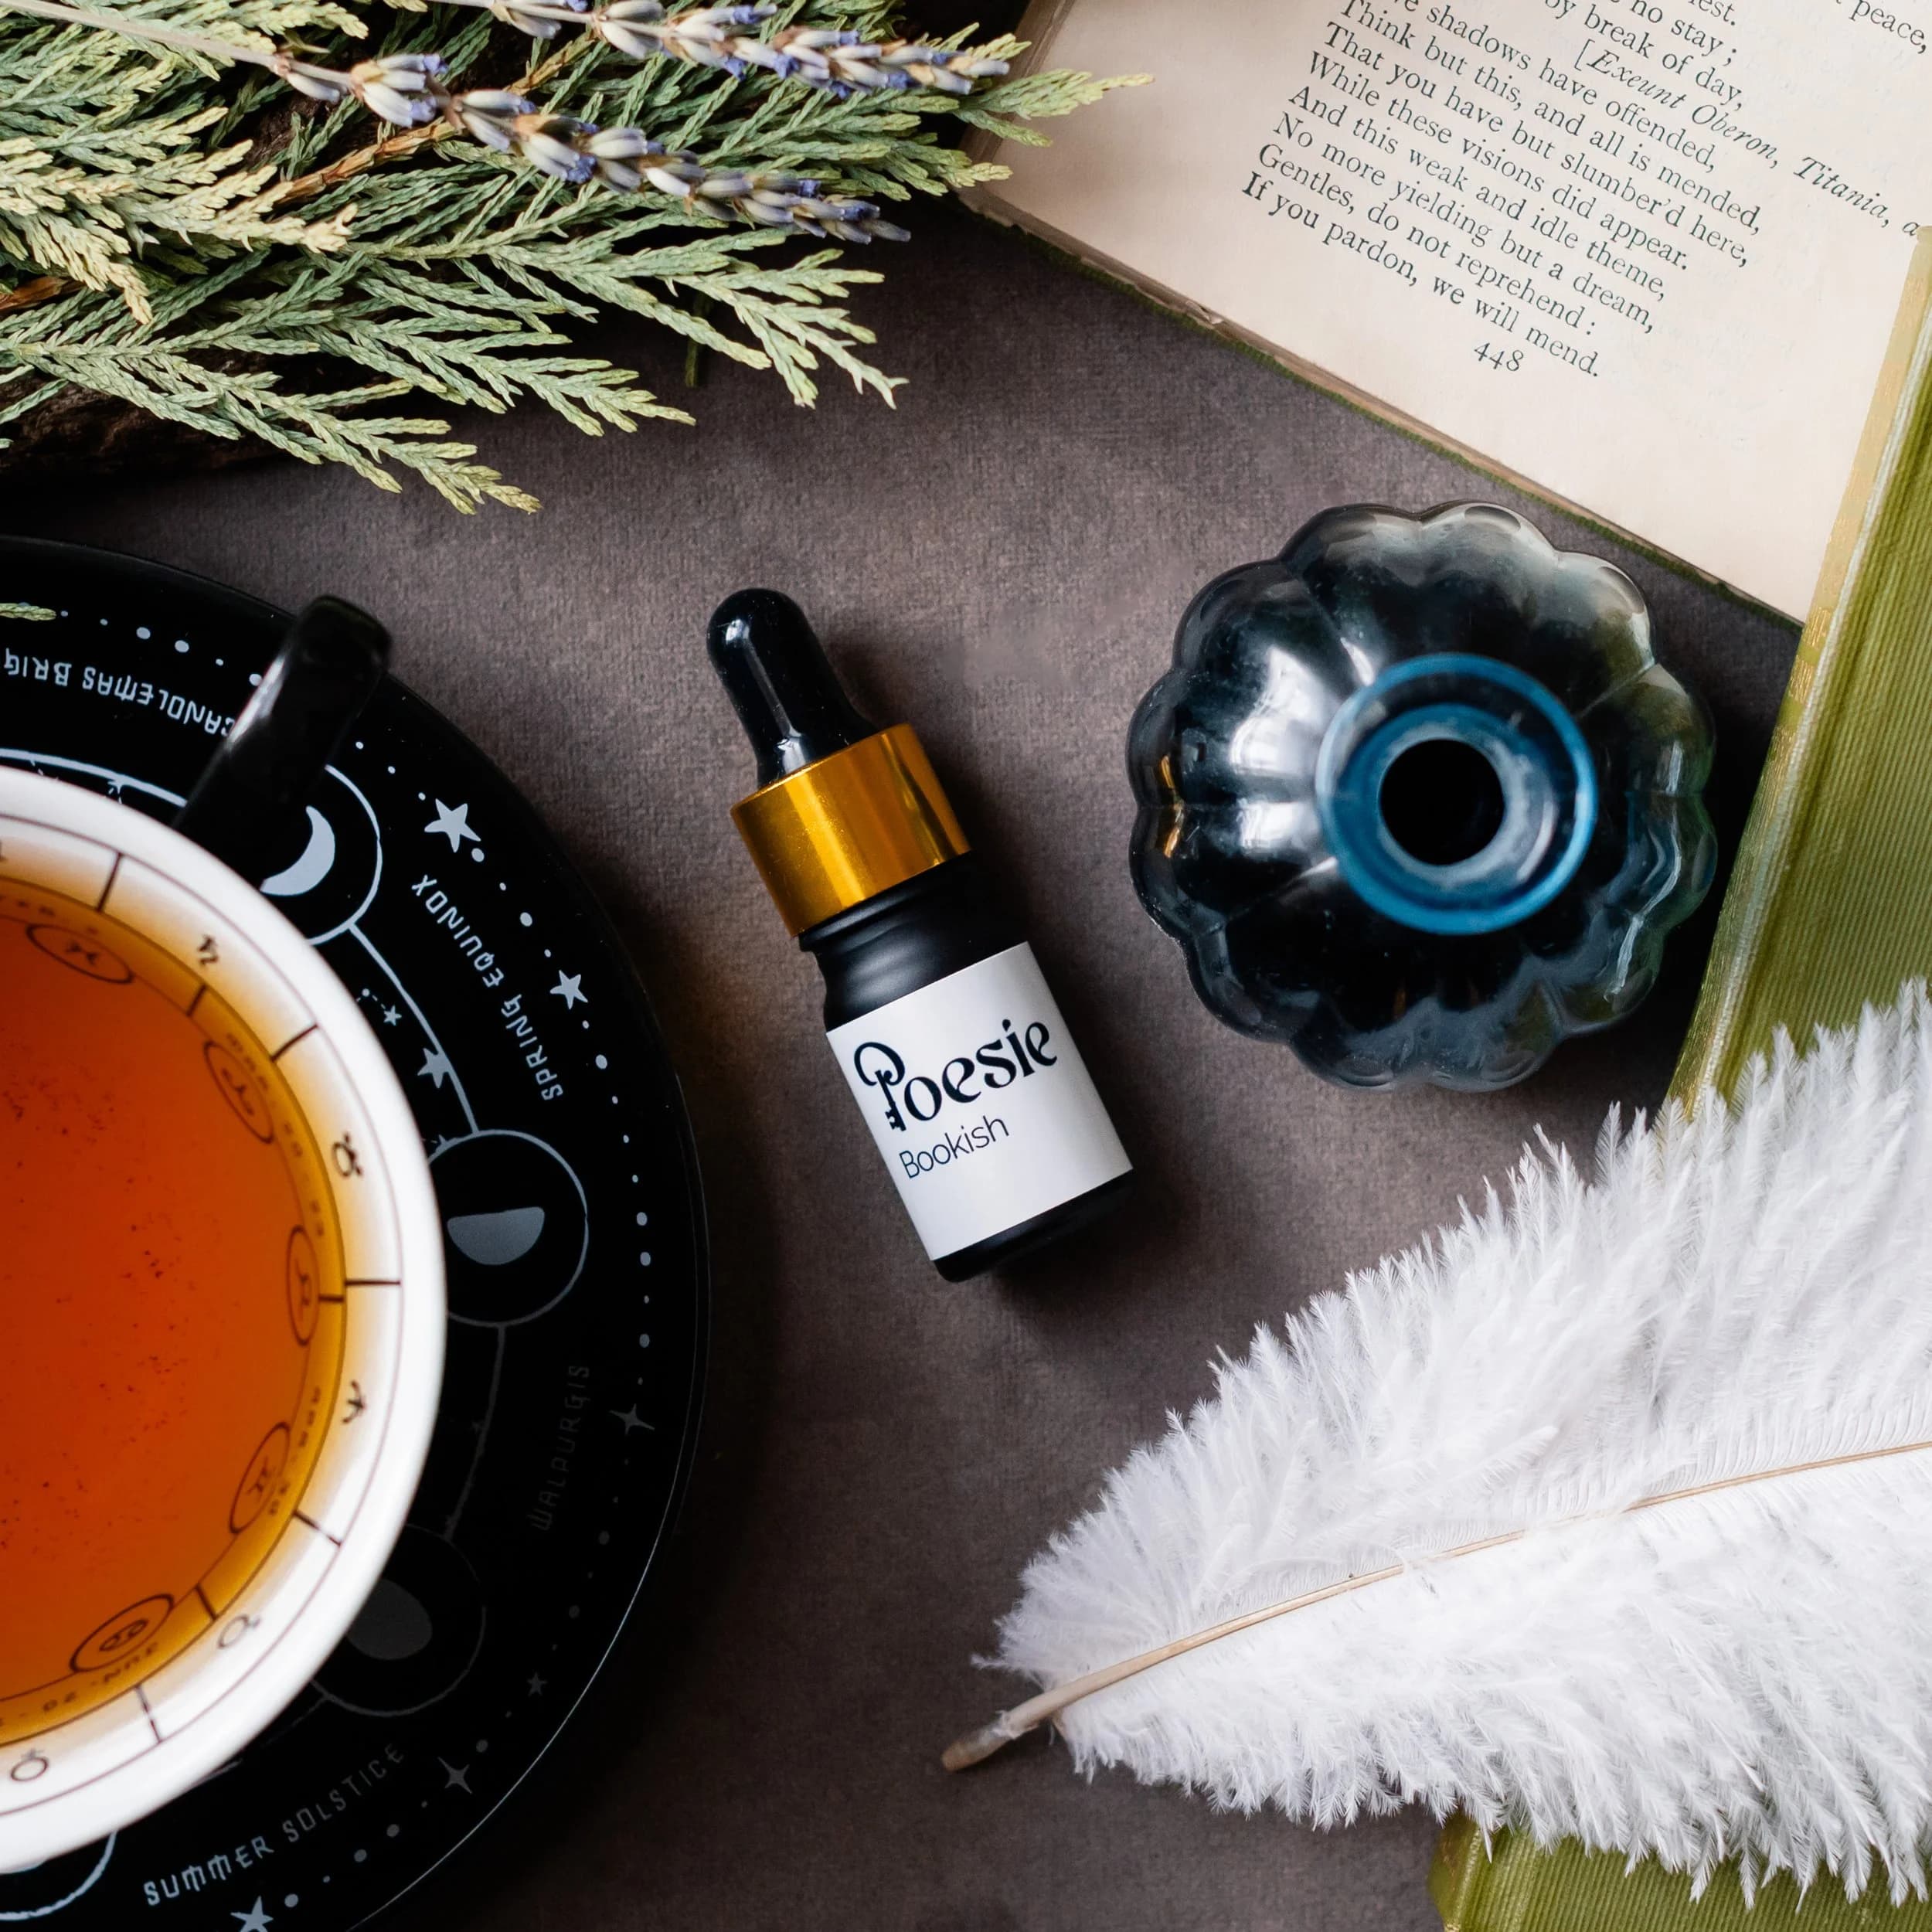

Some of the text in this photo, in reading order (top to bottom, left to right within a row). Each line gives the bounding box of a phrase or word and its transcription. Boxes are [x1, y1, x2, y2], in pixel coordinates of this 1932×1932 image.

[1427, 5, 1532, 71] shadows
[1539, 58, 1598, 105] have
[1605, 100, 1716, 174] offended,
[1584, 3, 1655, 60] break
[1662, 54, 1694, 74] of
[1695, 67, 1743, 112] day,
[1629, 0, 1663, 23] no
[1688, 0, 1736, 26] est.
[1849, 0, 1927, 54] peace,
[1288, 86, 1665, 302] And this weak and idle theme,
[1307, 51, 1688, 270] While these visions did appear.
[1324, 22, 1747, 268] That you have but slumber'd here,
[1341, 0, 1761, 236] Think but this, and all is mended,
[1574, 39, 1687, 109] [Exeunt
[1691, 104, 1777, 169] Oberon,
[1793, 156, 1889, 229] Titania,
[1243, 171, 1599, 378] If you pardon, we will mend.
[1259, 143, 1355, 216] Gentles,
[1367, 202, 1400, 232] do
[1406, 226, 1451, 260] not
[1274, 114, 1654, 334] No more yielding but a dream,
[1474, 342, 1525, 372] 448
[411, 874, 564, 1101] SPRING EQUINOX
[853, 1019, 1058, 1132] Poesie
[899, 1115, 1010, 1179] Bookish
[526, 1366, 591, 1532] WALPURGIS
[143, 1742, 406, 1907] SUMMER SOLSTICE
